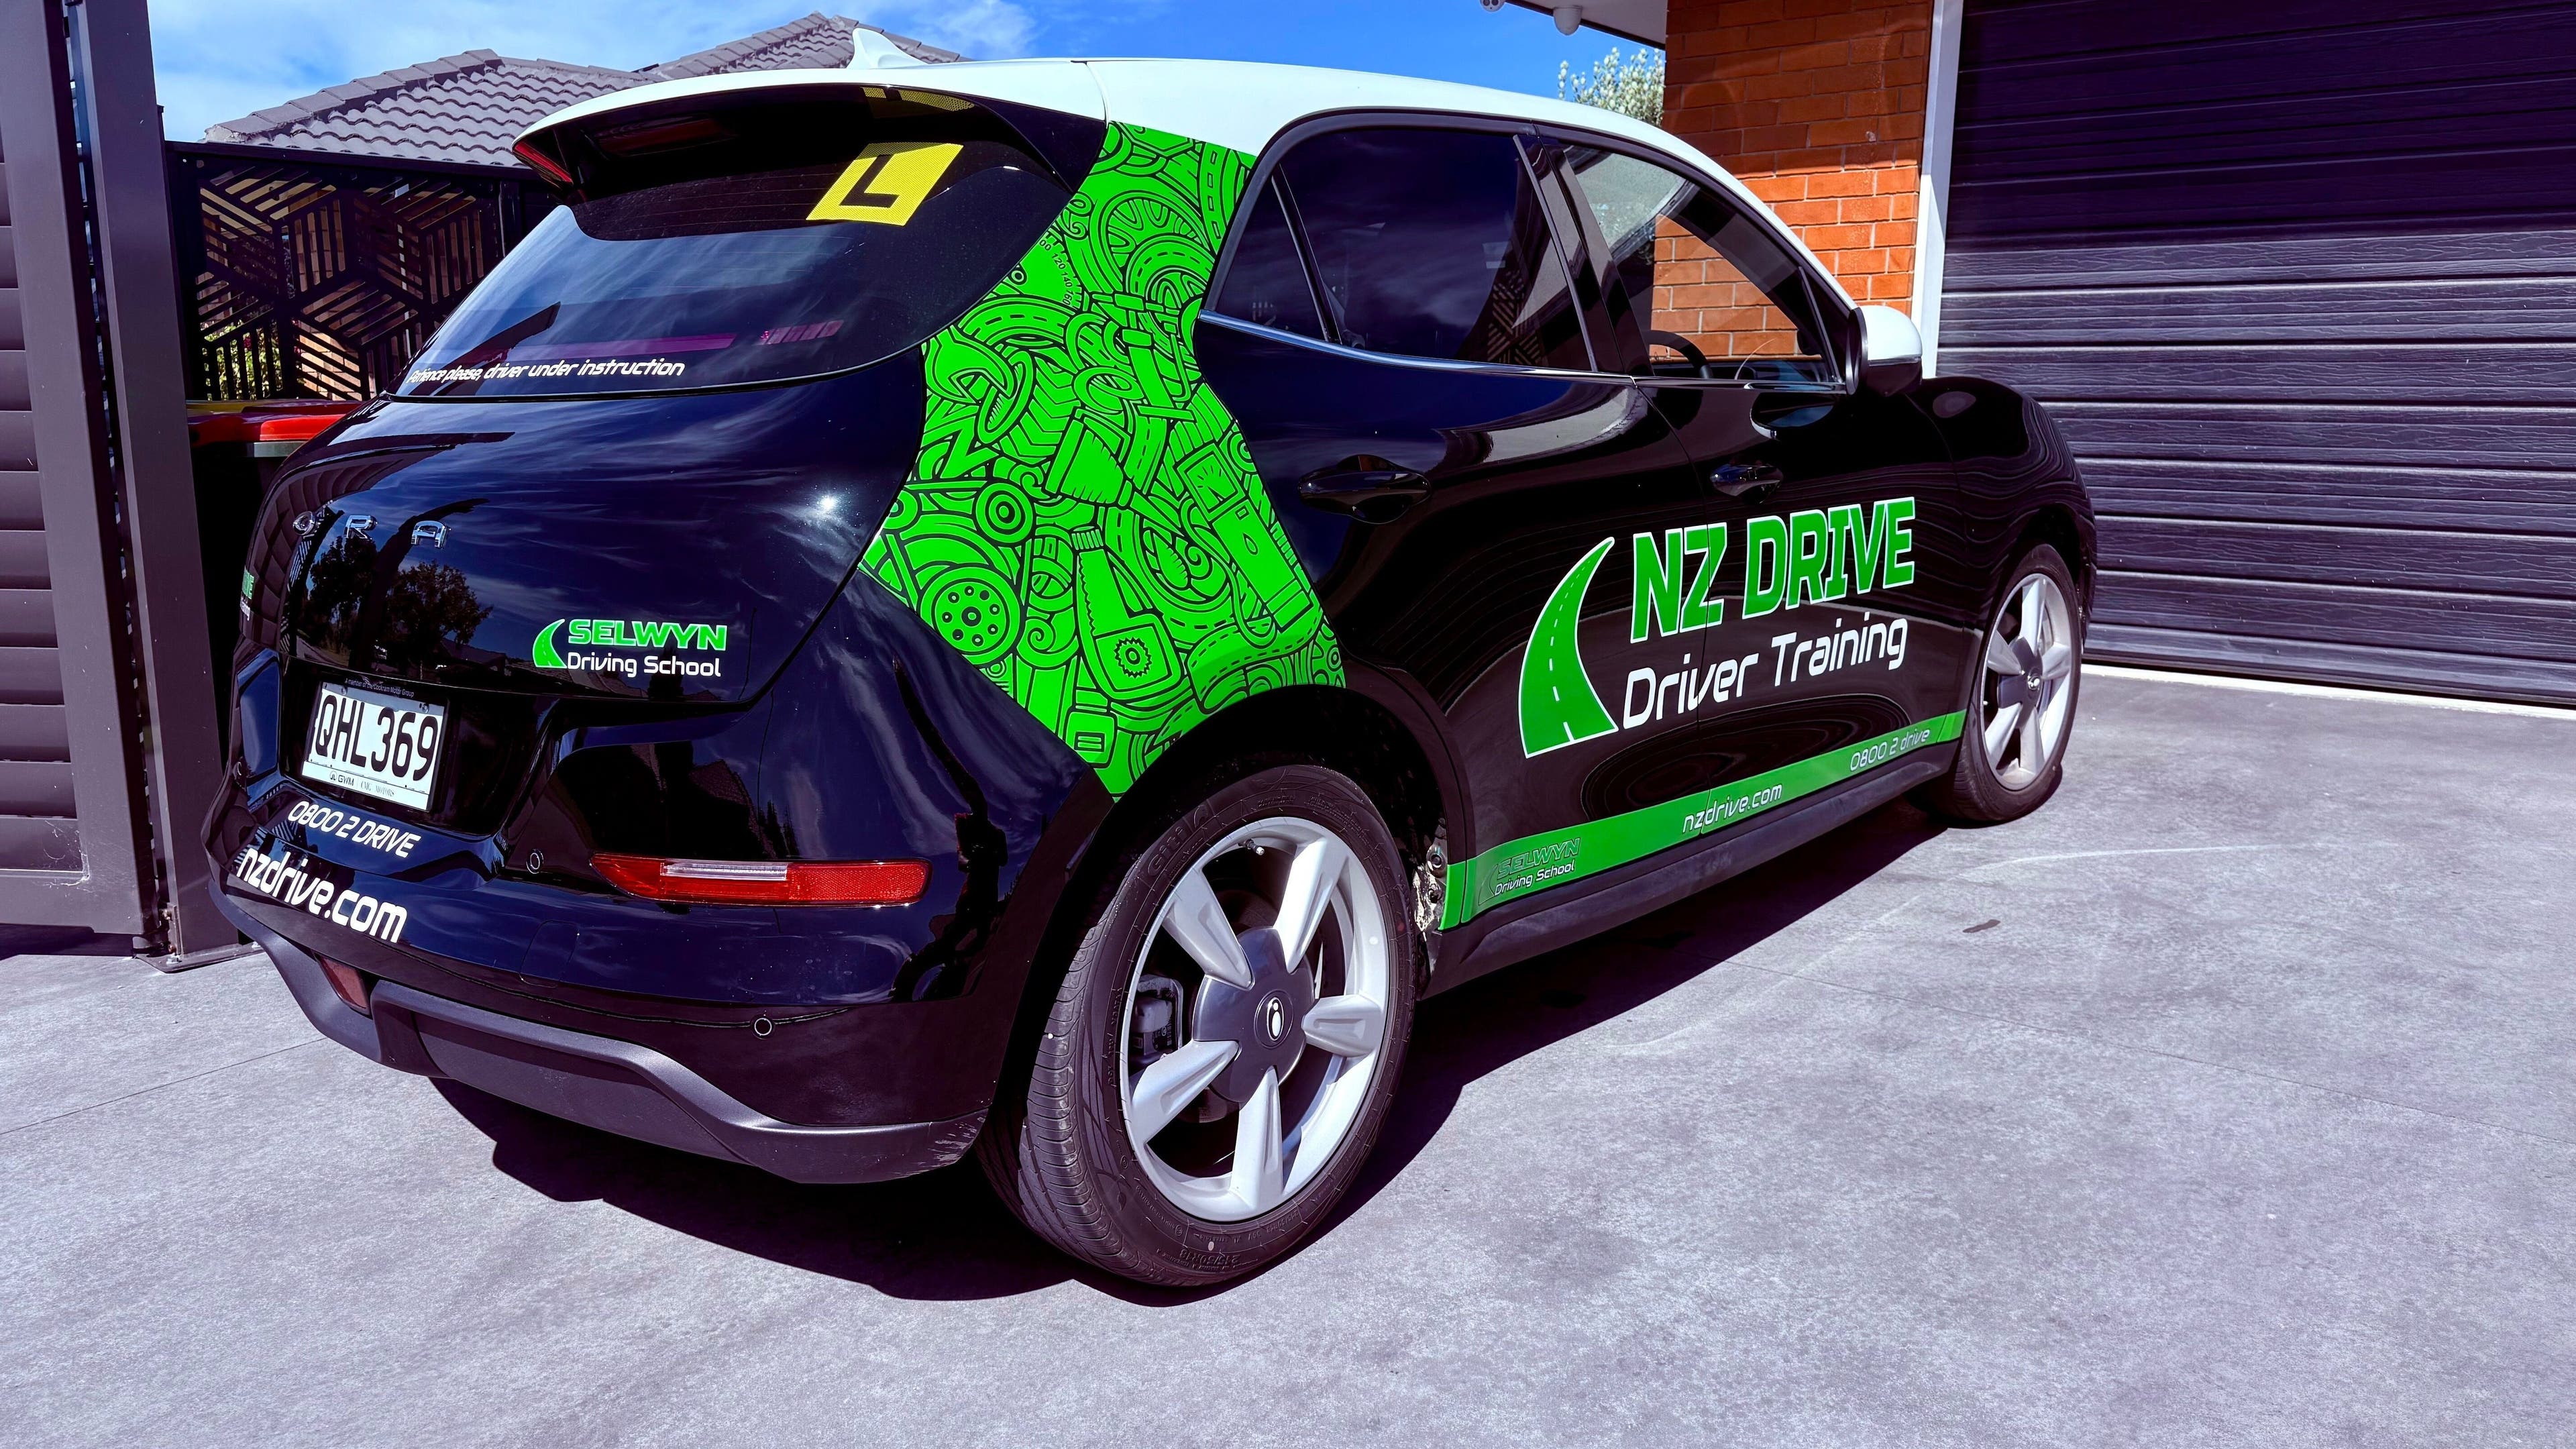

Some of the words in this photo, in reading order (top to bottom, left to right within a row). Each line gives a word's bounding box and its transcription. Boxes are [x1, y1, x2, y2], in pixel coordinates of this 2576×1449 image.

[839, 154, 900, 209] L
[1039, 239, 1051, 251] 00
[1051, 253, 1066, 270] 120
[1061, 272, 1073, 288] 140
[1063, 290, 1073, 305] 160
[441, 365, 483, 383] please,
[484, 363, 529, 379] driver
[528, 360, 579, 377] under
[577, 358, 685, 376] instruction
[1629, 522, 1727, 645] NZ
[1742, 496, 1915, 620] DRIVE
[568, 619, 727, 651] SELWYN
[568, 651, 637, 678] Driving
[643, 655, 721, 677] School
[1623, 653, 1760, 729] Driver
[1771, 612, 1908, 686] Training
[402, 688, 414, 698] Group
[315, 694, 438, 781] QHL369
[1850, 741, 1887, 771] 0800
[1889, 737, 1898, 755] 2
[1900, 729, 1930, 751] drive
[338, 775, 354, 786] GWM
[1682, 784, 1782, 833] nzdrive.com
[288, 801, 344, 832] 0800
[335, 815, 360, 839] 2
[352, 820, 422, 858] DRIVE
[1497, 837, 1580, 879] SELWYN
[236, 848, 408, 943] nzdrive.com
[1495, 874, 1533, 896] Driving
[1536, 859, 1575, 881] School
